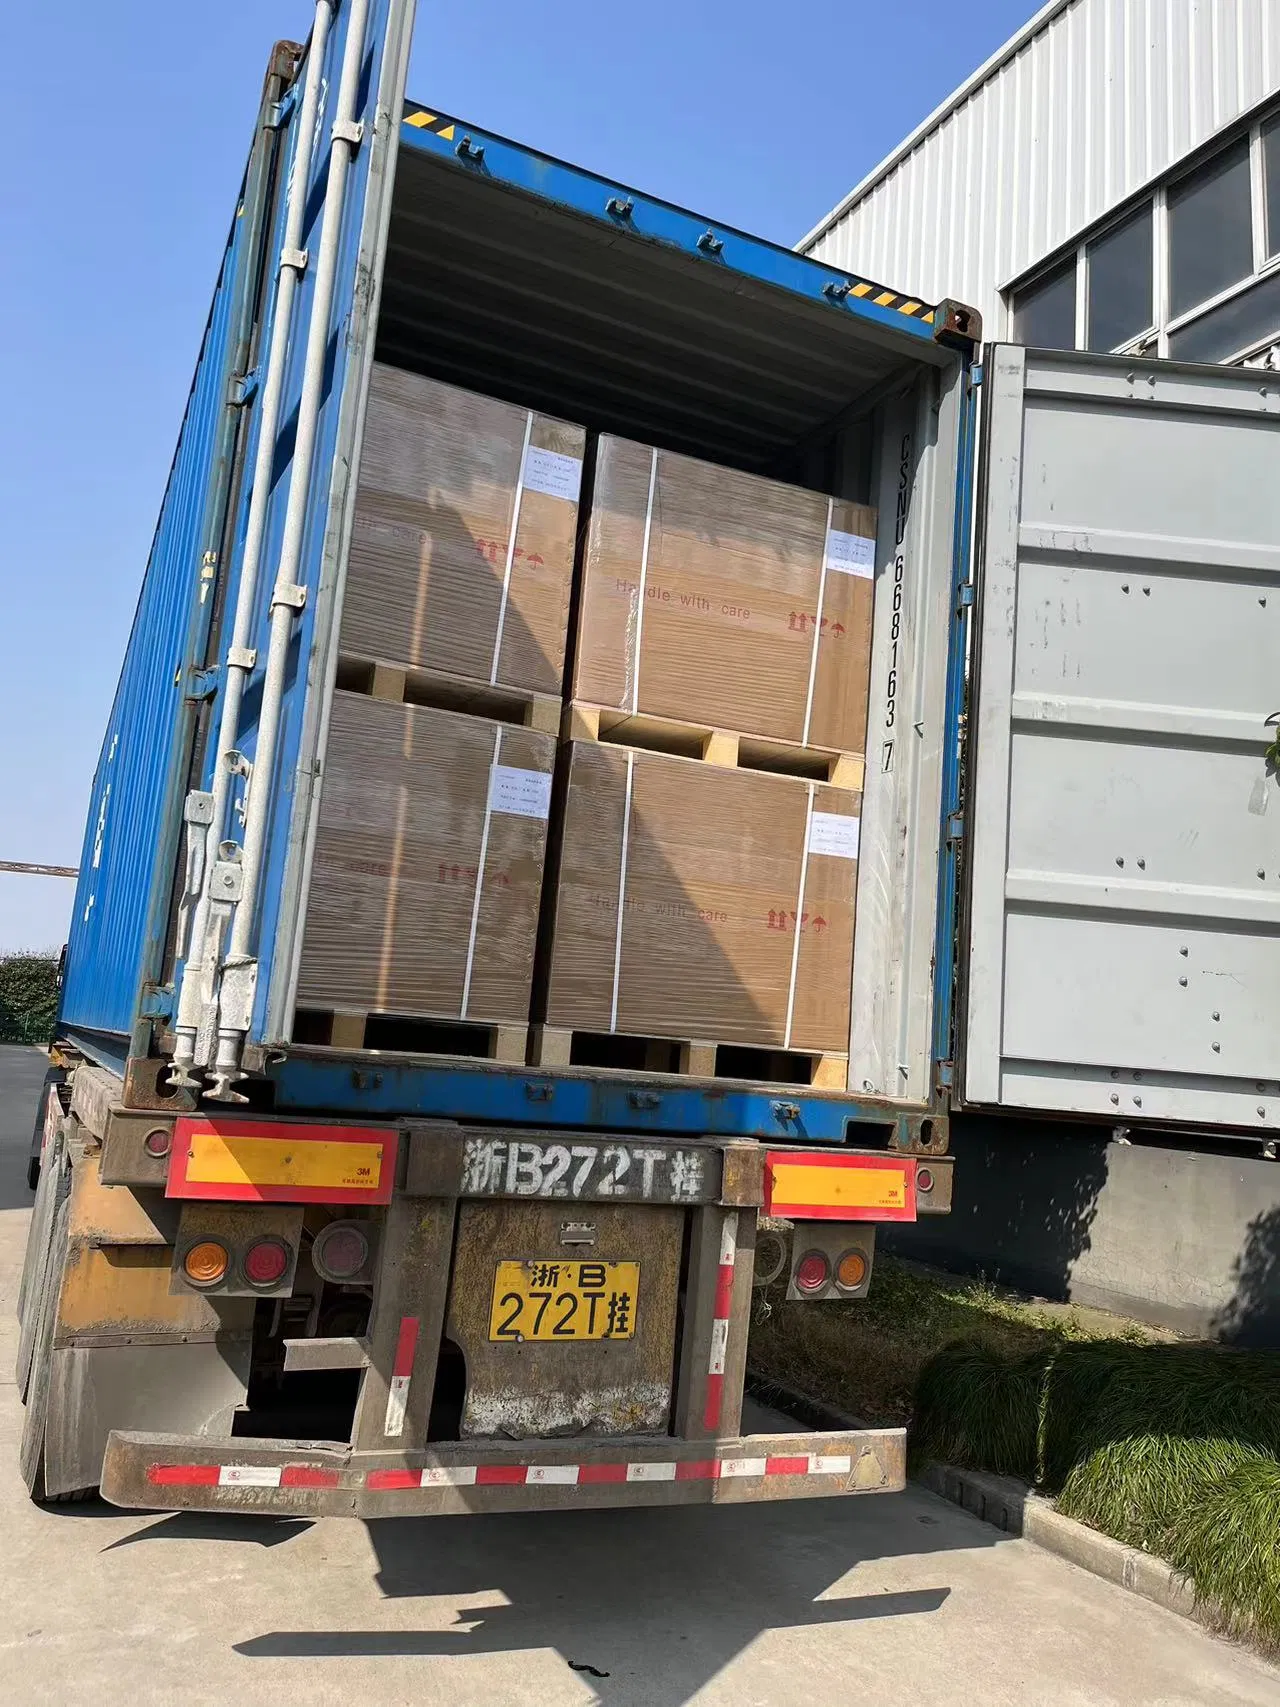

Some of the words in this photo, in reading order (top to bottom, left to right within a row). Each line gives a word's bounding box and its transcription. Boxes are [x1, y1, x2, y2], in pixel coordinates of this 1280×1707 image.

[896, 434, 910, 546] CSNU
[680, 593, 709, 611] with
[721, 604, 750, 619] care
[885, 555, 903, 728] 668163
[697, 908, 728, 922] care
[497, 1292, 631, 1336] 272T挂
